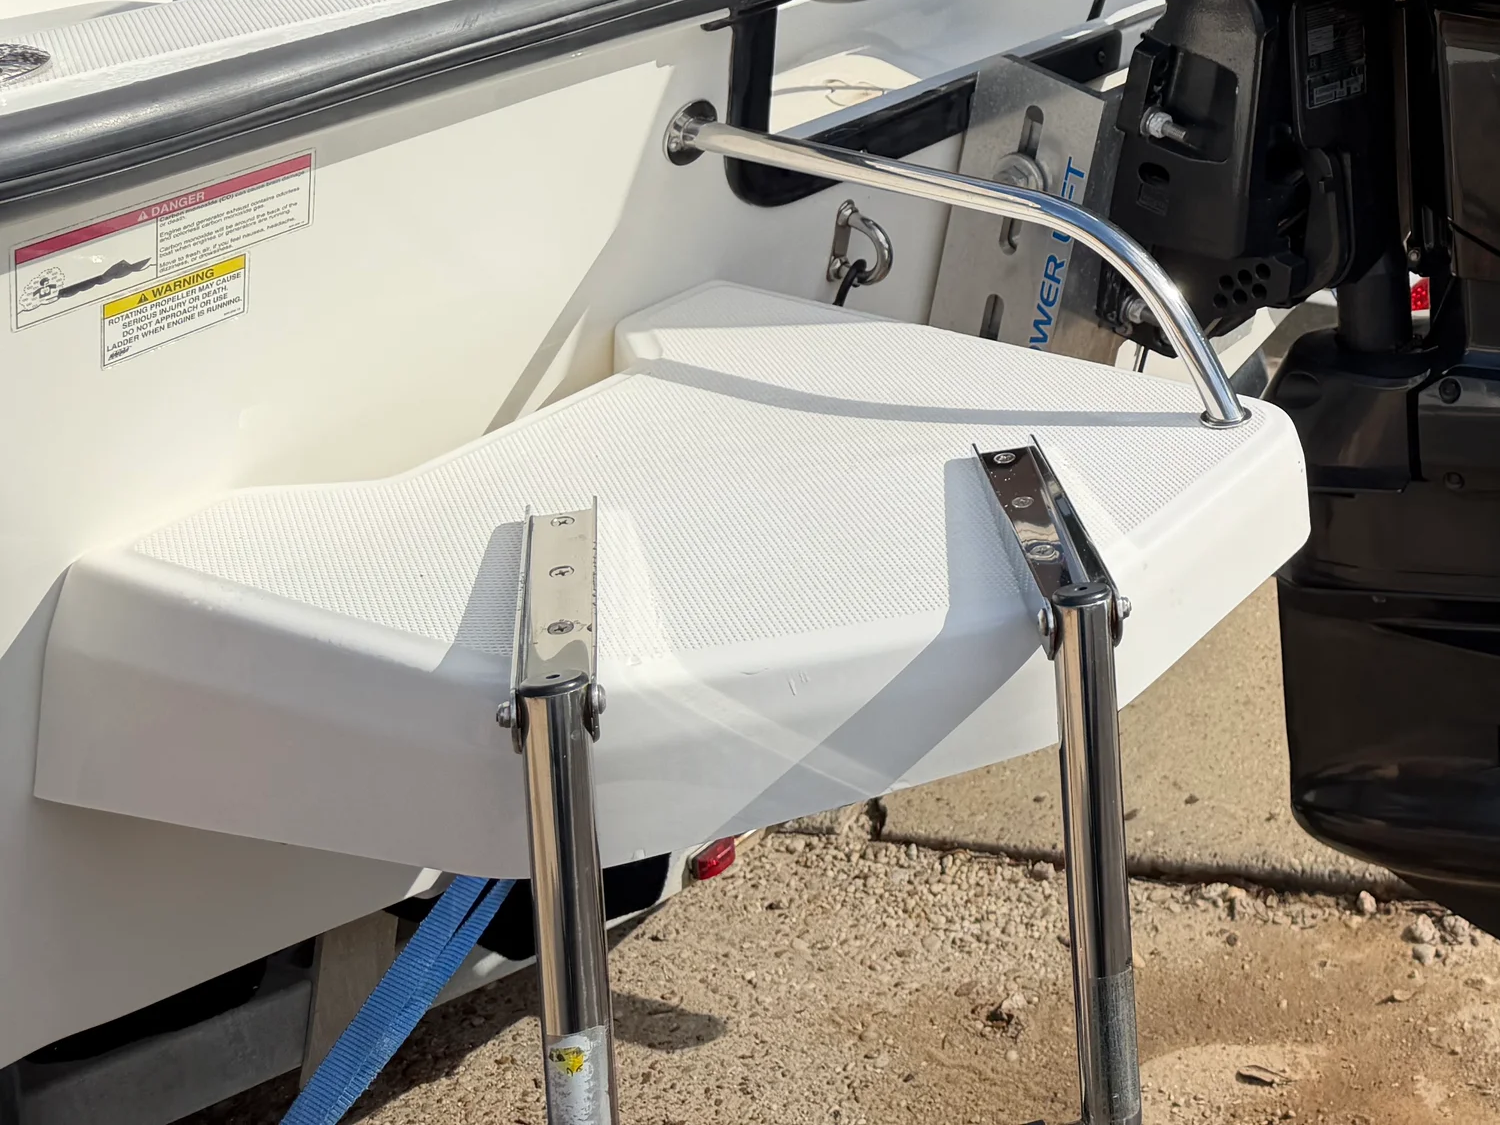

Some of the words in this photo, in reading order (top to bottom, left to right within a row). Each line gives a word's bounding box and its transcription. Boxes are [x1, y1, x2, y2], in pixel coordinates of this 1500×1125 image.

[151, 191, 206, 217] DANGER
[159, 211, 184, 221] Carbon
[159, 241, 182, 253] Carbon
[108, 306, 147, 326] ROTATING
[150, 288, 196, 310] PROPELLER
[198, 281, 214, 292] MAY
[216, 271, 241, 285] CAUSE
[152, 268, 214, 298] WARNING
[1029, 254, 1066, 351] WER
[106, 334, 139, 352] LADDER
[141, 324, 165, 338] WHEN
[167, 312, 195, 328] ENGINE
[197, 309, 204, 317] IS
[207, 295, 242, 314] RUNNING.
[122, 311, 156, 329] SERIOUS
[159, 299, 186, 315] INJURY
[188, 294, 199, 304] OR
[202, 284, 228, 299] DEATH.
[122, 327, 134, 337] DO
[136, 320, 152, 332] NOT
[155, 303, 198, 325] APPROACH
[200, 298, 210, 308] OR
[213, 292, 228, 303] USE
